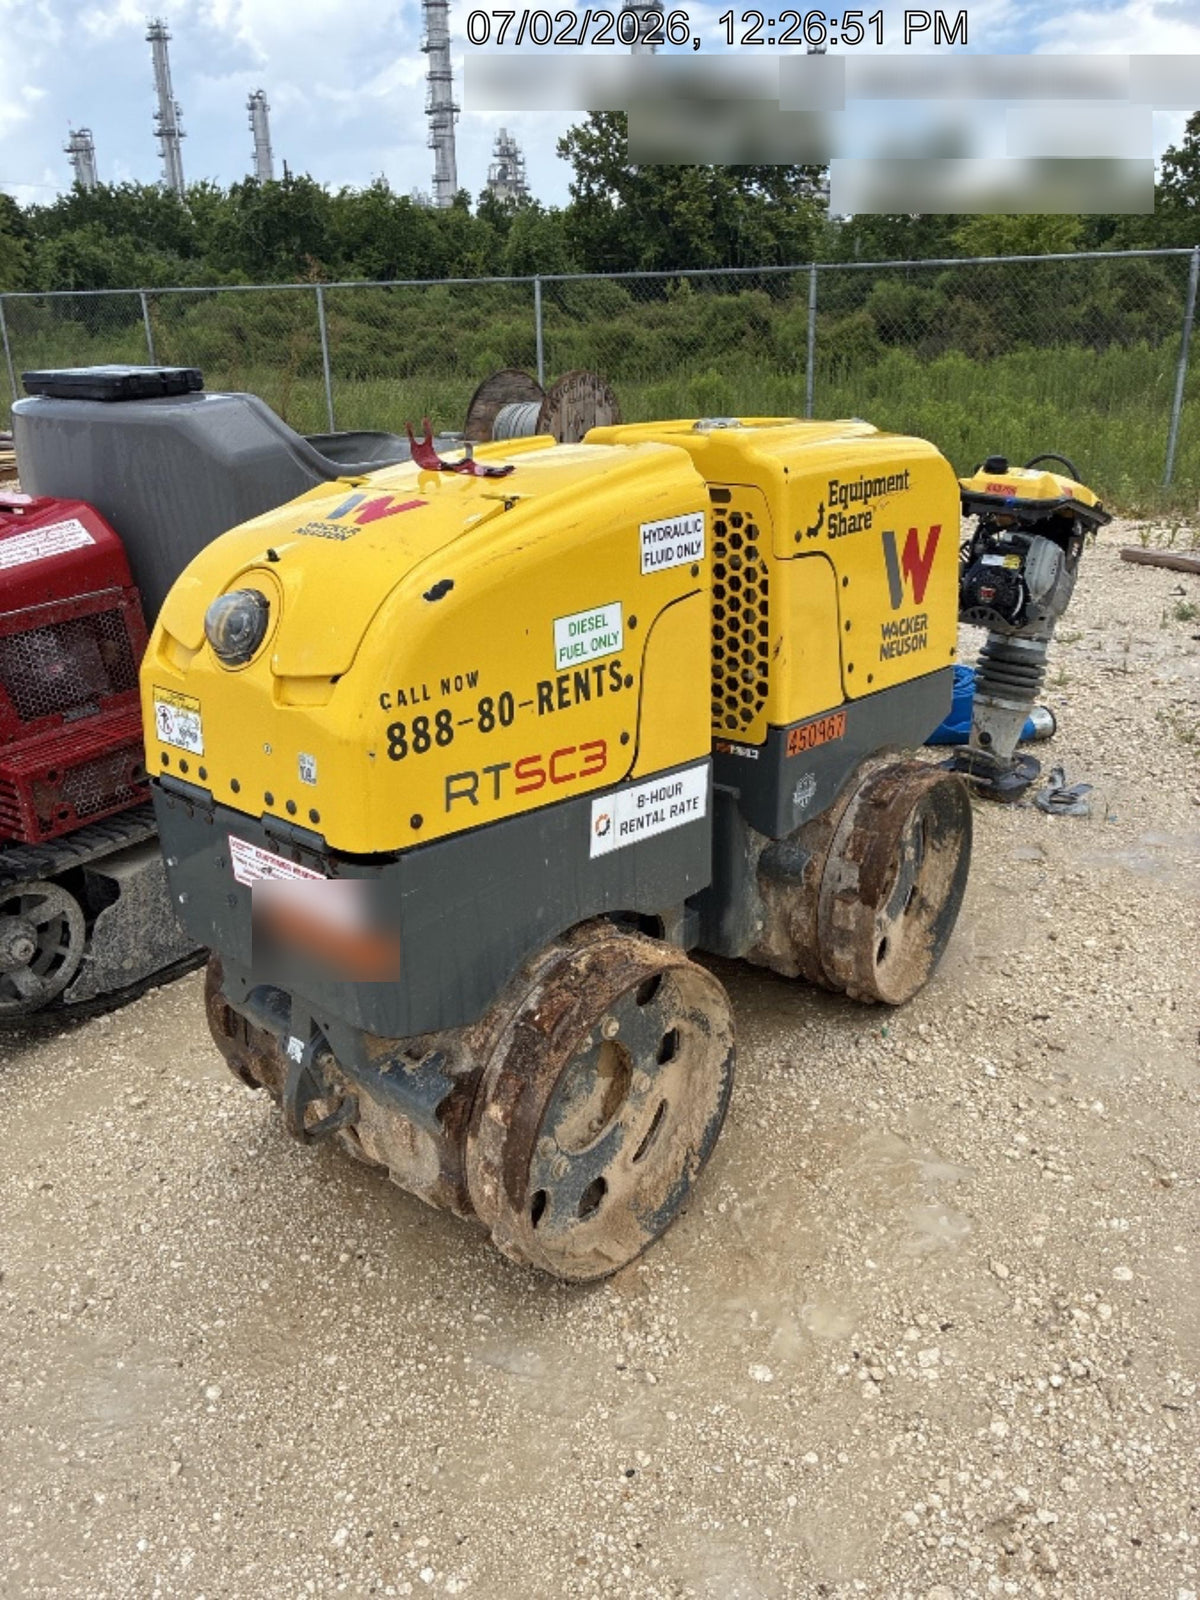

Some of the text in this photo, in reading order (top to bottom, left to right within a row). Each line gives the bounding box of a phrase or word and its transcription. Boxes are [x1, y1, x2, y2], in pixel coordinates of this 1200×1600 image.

[828, 469, 910, 510] Equipment
[643, 518, 702, 545] HYDRAULIC
[828, 511, 872, 540] Share
[644, 540, 702, 567] FLUID ONLY
[568, 613, 609, 637] DIESEL
[881, 612, 928, 641] WACKER
[559, 630, 619, 662] FUEL ONLY
[880, 633, 928, 661] NEUSON
[380, 670, 479, 710] CALL NOW
[445, 739, 607, 812] RTSC3
[620, 796, 699, 836] RENTAL RATE
